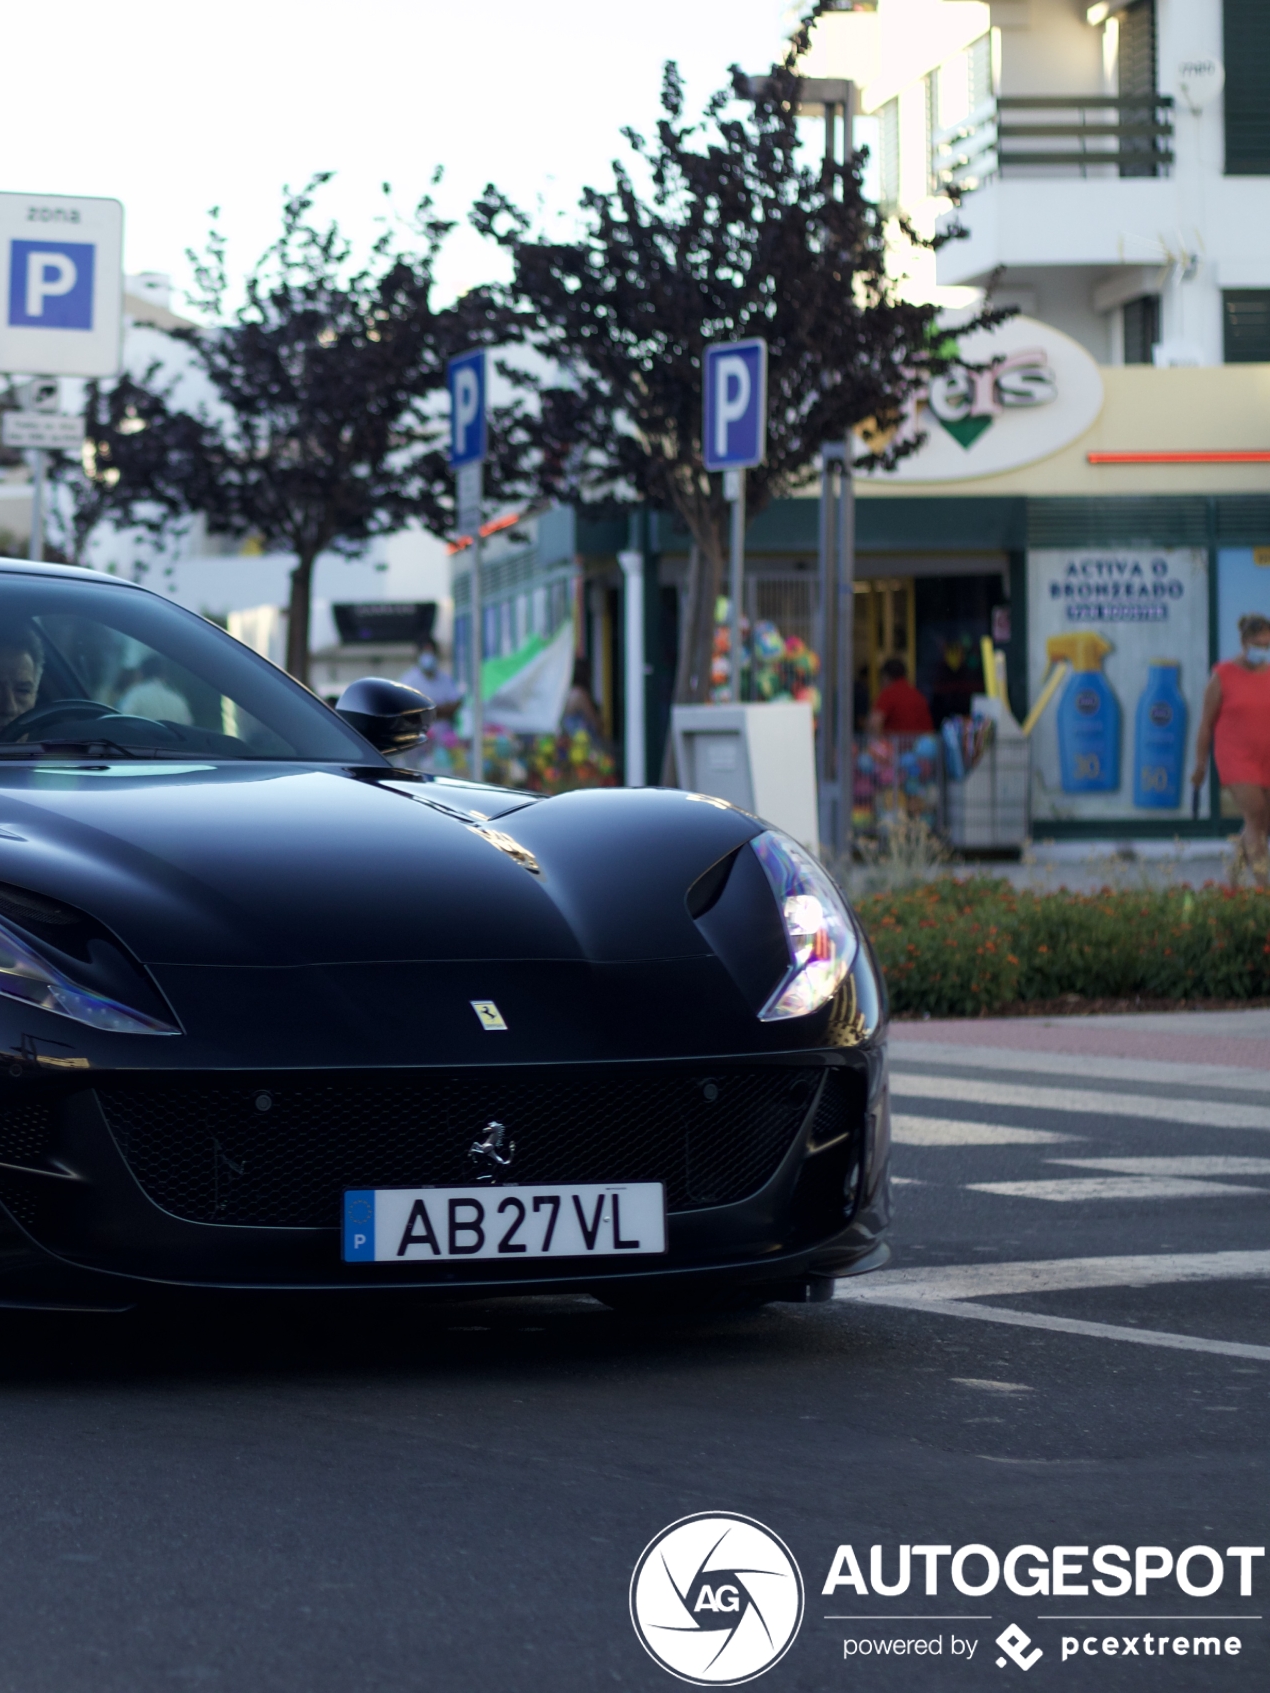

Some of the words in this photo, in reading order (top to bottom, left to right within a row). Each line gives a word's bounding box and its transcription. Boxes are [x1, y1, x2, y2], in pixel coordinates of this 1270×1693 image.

[27, 205, 81, 224] zona
[25, 252, 77, 317] P
[453, 367, 479, 454] P
[715, 355, 751, 457] P
[1067, 559, 1142, 577] ACTIVA
[1152, 558, 1168, 577] O
[1050, 580, 1184, 600] BRONZEADO
[353, 1234, 367, 1249] P
